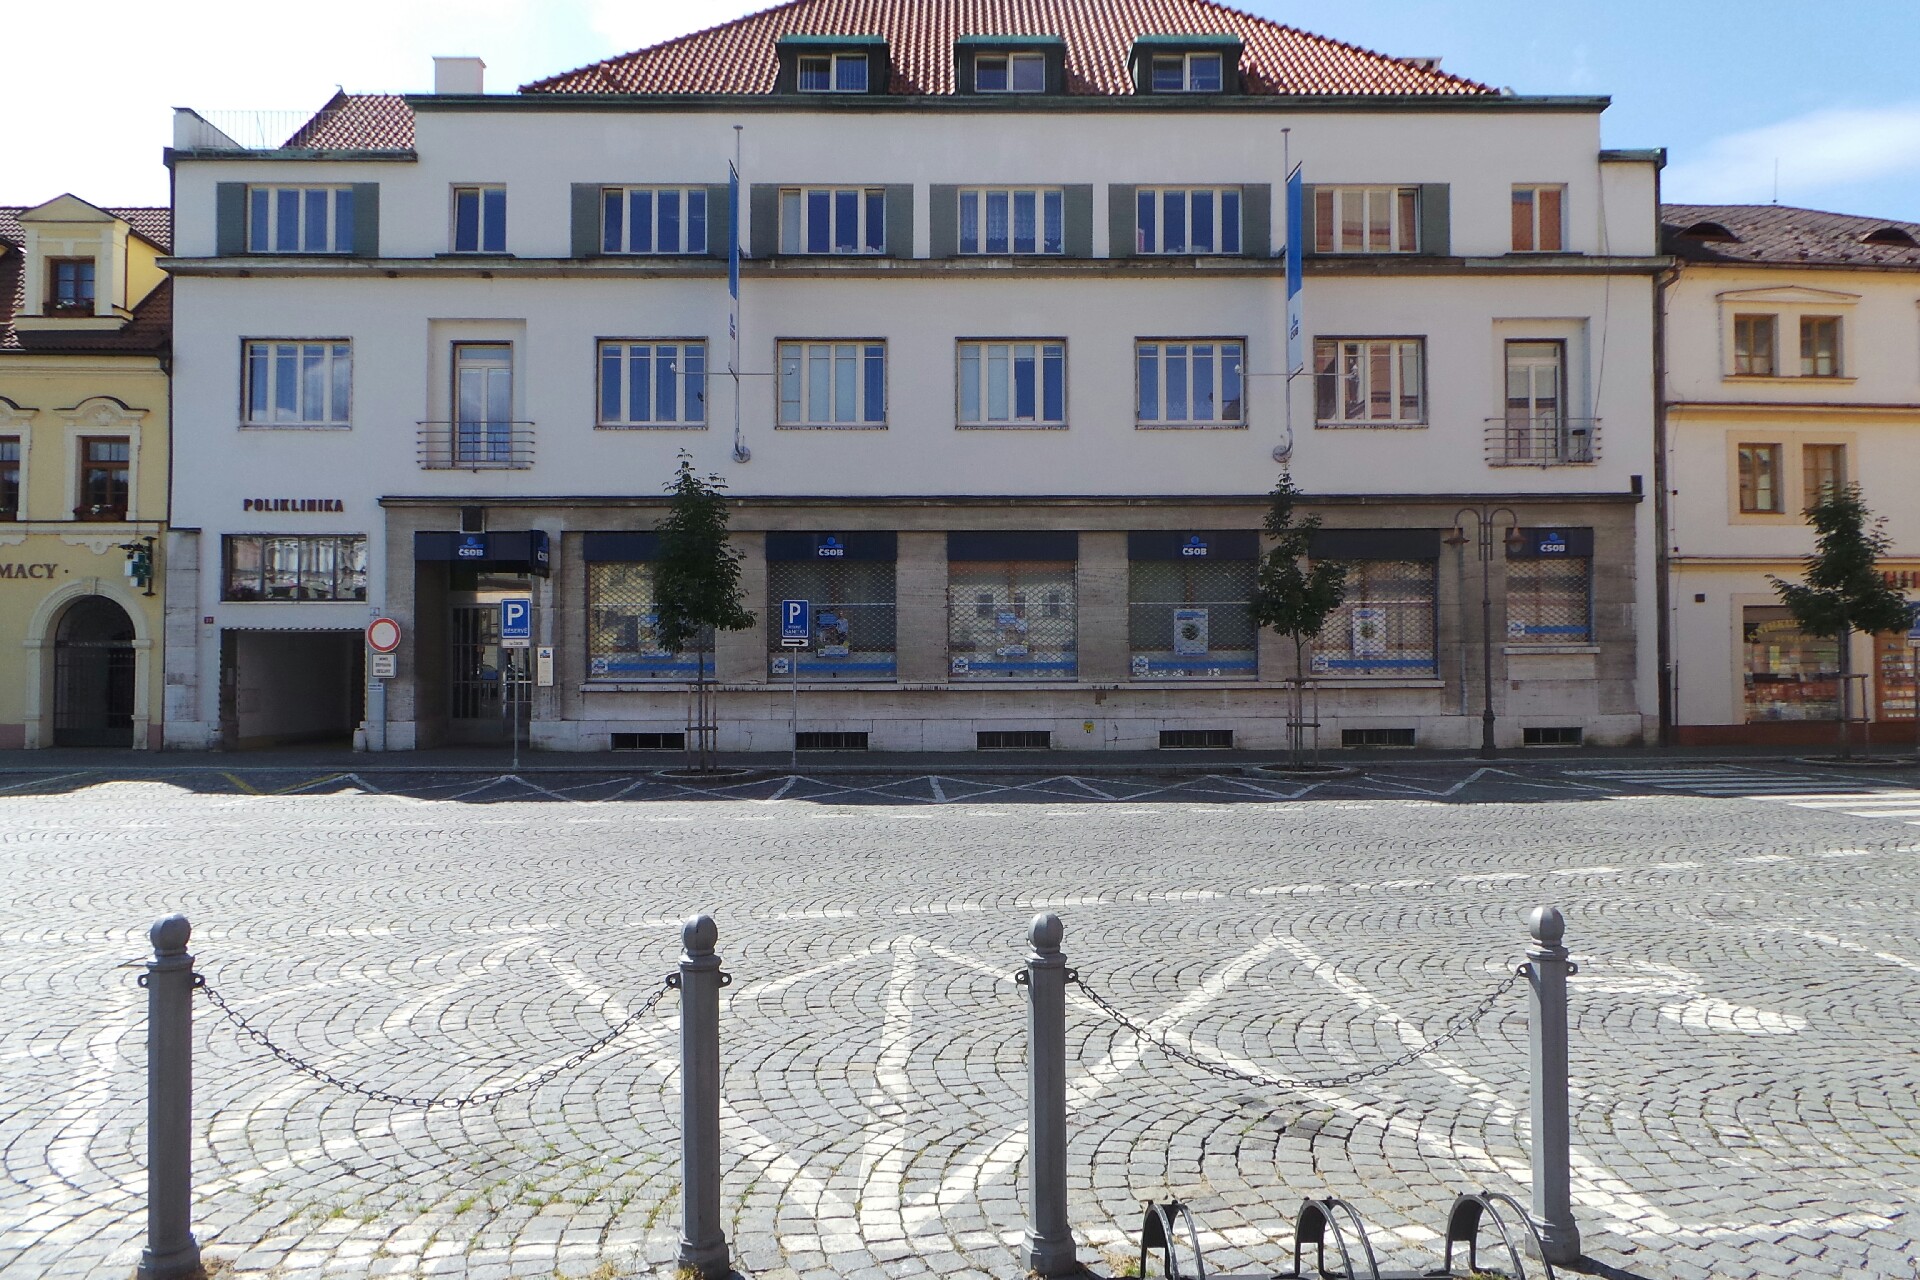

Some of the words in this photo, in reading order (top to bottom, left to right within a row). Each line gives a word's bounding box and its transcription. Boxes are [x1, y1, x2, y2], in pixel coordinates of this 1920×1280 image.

[243, 498, 344, 512] POLIKLINIKA
[458, 548, 484, 556] ČSOB
[818, 548, 844, 556] ČSOB
[1182, 547, 1208, 556] ČSOB
[1540, 544, 1566, 552] ČSOB
[0, 563, 58, 579] MACY
[507, 603, 524, 626] P
[789, 602, 801, 624] P
